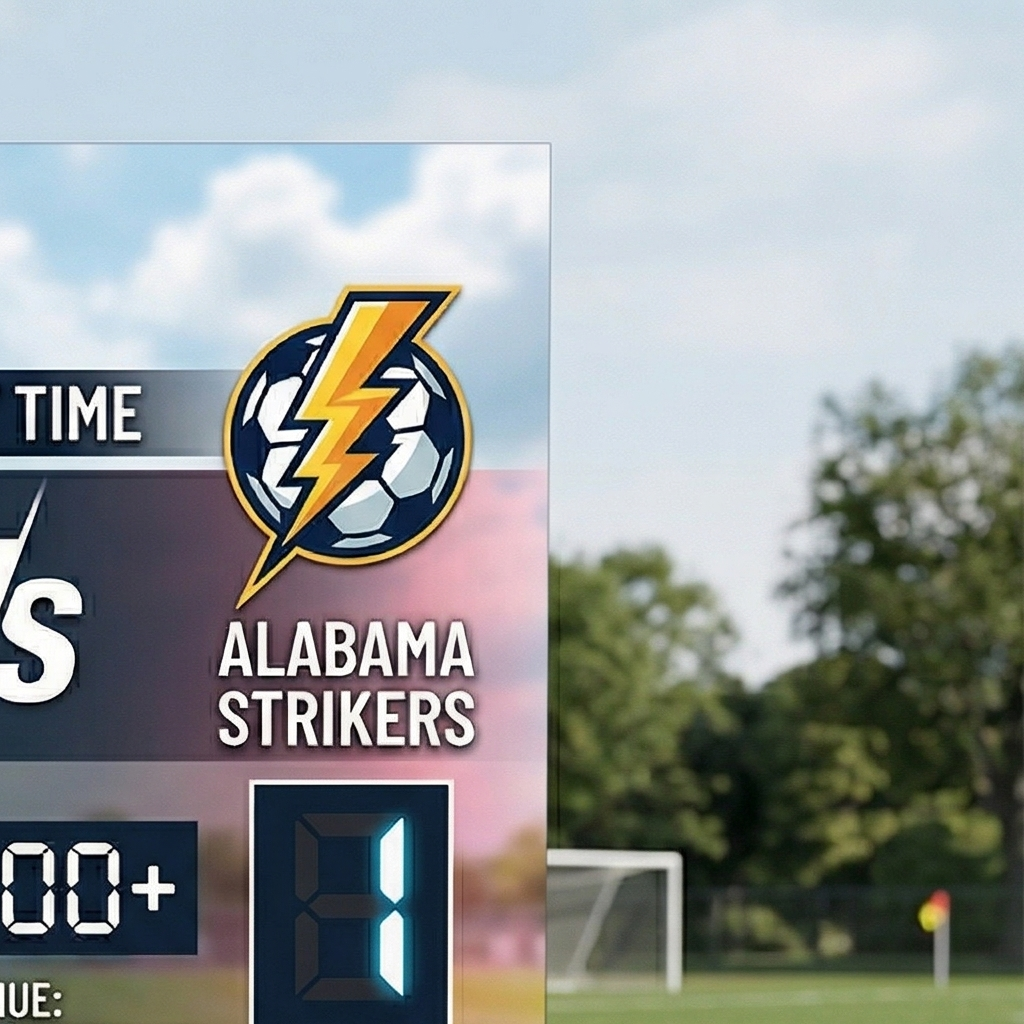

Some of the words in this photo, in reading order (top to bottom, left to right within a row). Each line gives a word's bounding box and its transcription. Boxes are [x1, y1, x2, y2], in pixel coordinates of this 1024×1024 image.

[15, 385, 142, 441] TIME
[218, 621, 475, 677] ALABAMA
[218, 690, 475, 747] STRIKERS
[379, 818, 404, 996] 1
